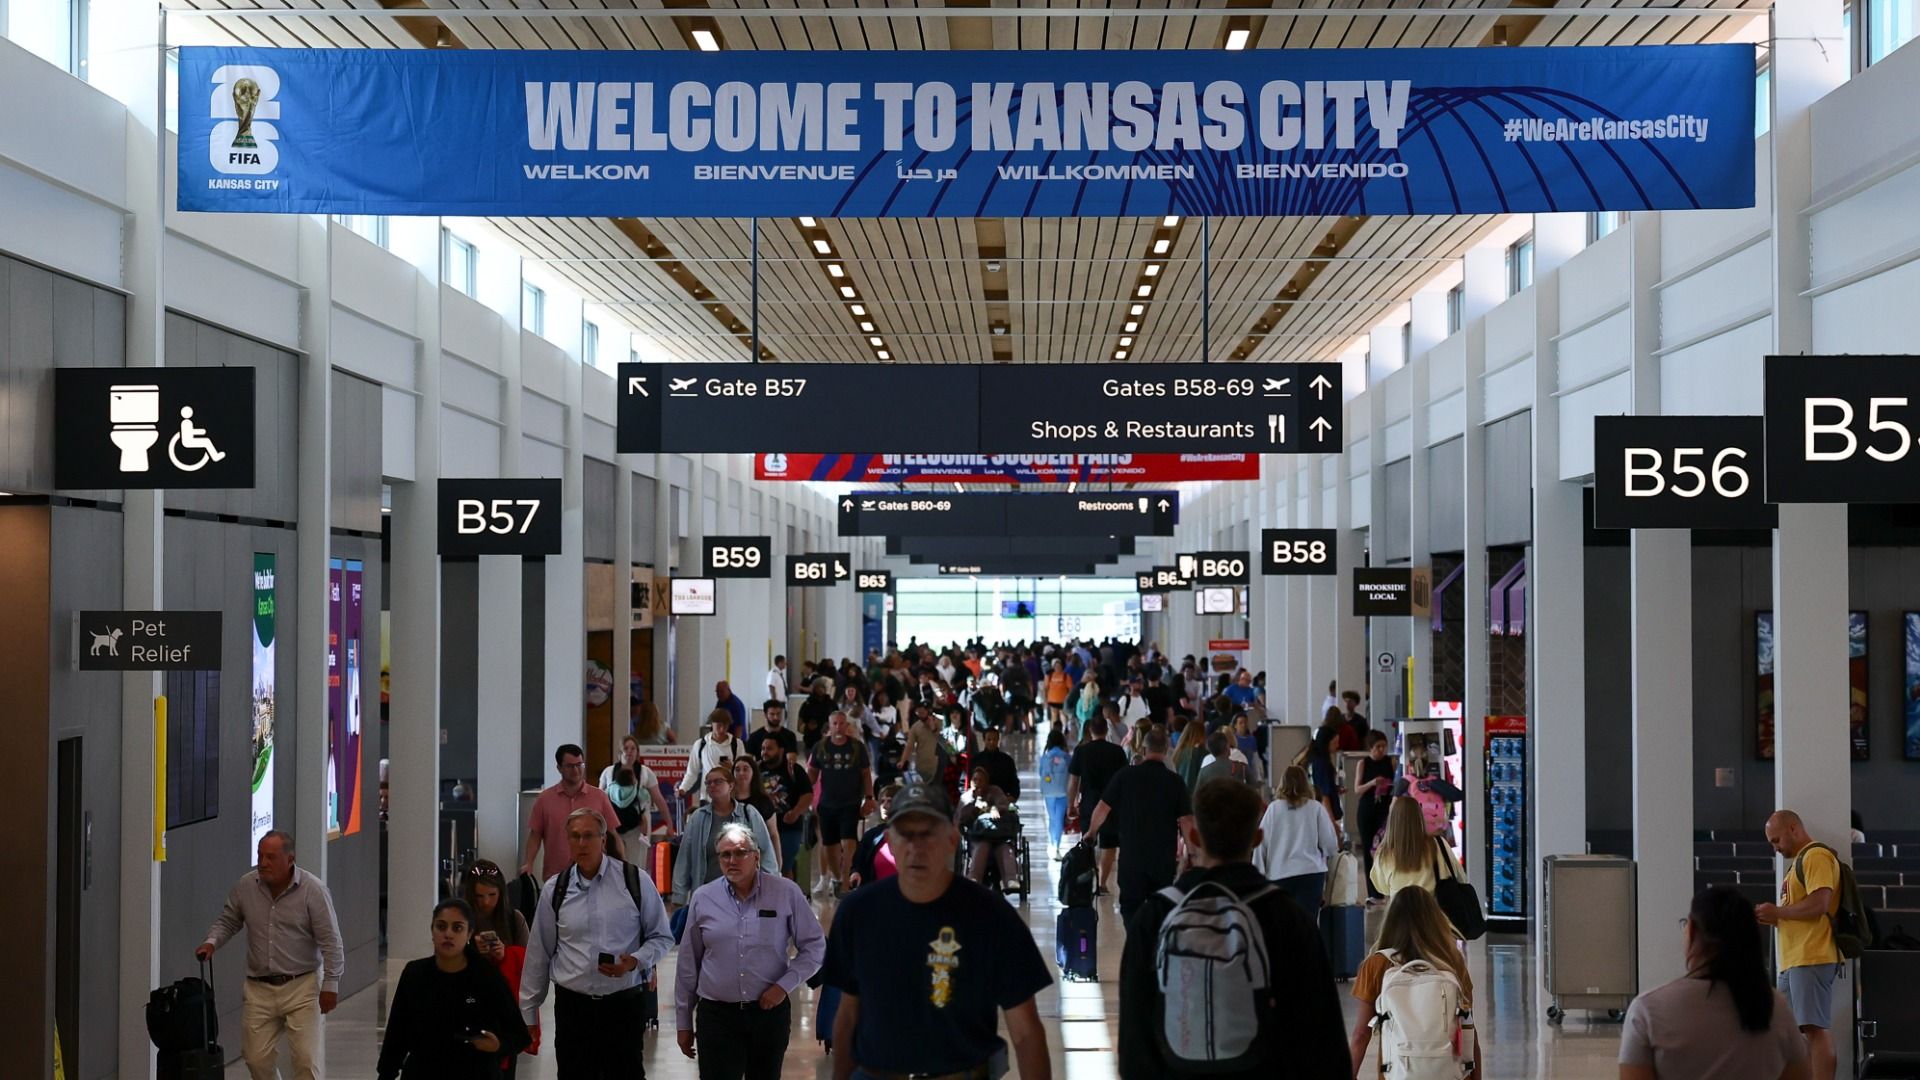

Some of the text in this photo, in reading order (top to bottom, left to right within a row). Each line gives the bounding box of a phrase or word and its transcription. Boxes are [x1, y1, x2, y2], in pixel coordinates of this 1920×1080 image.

[525, 80, 1411, 152] WELCOME TO KANSAS CITY
[1503, 114, 1709, 143] #WeAreKansasCity
[229, 152, 261, 165] FIFA
[523, 164, 649, 180] WELKOM
[694, 165, 855, 181] BIENVENUE
[997, 164, 1195, 180] WILLKOMMEN
[1236, 162, 1409, 179] BIENVENIDO
[208, 178, 279, 190] KANSAS CITY
[705, 378, 807, 397] Gate B57
[1102, 378, 1254, 397] Gates B58-69
[1031, 420, 1255, 442] Shops & Restaurants
[1805, 397, 1920, 462] B5
[920, 467, 972, 475] BIENVENUE
[1015, 467, 1079, 475] WILLKOMMEN
[1090, 467, 1146, 475] BIENVENIDO
[1624, 447, 1749, 498] B56
[877, 500, 952, 511] Gates B60-69
[1078, 500, 1134, 511] Restrooms
[459, 500, 539, 534] B57
[712, 546, 761, 568] B59
[1273, 540, 1327, 564] B58
[794, 562, 827, 579] B61
[1202, 559, 1244, 577] B60
[858, 574, 887, 588] B63
[1158, 571, 1187, 586] B6
[1359, 583, 1406, 592] BROOKSIDE
[1369, 592, 1397, 600] LOCAL
[132, 619, 166, 637] Pet
[131, 644, 191, 663] Relief
[643, 759, 677, 767] WELCOME
